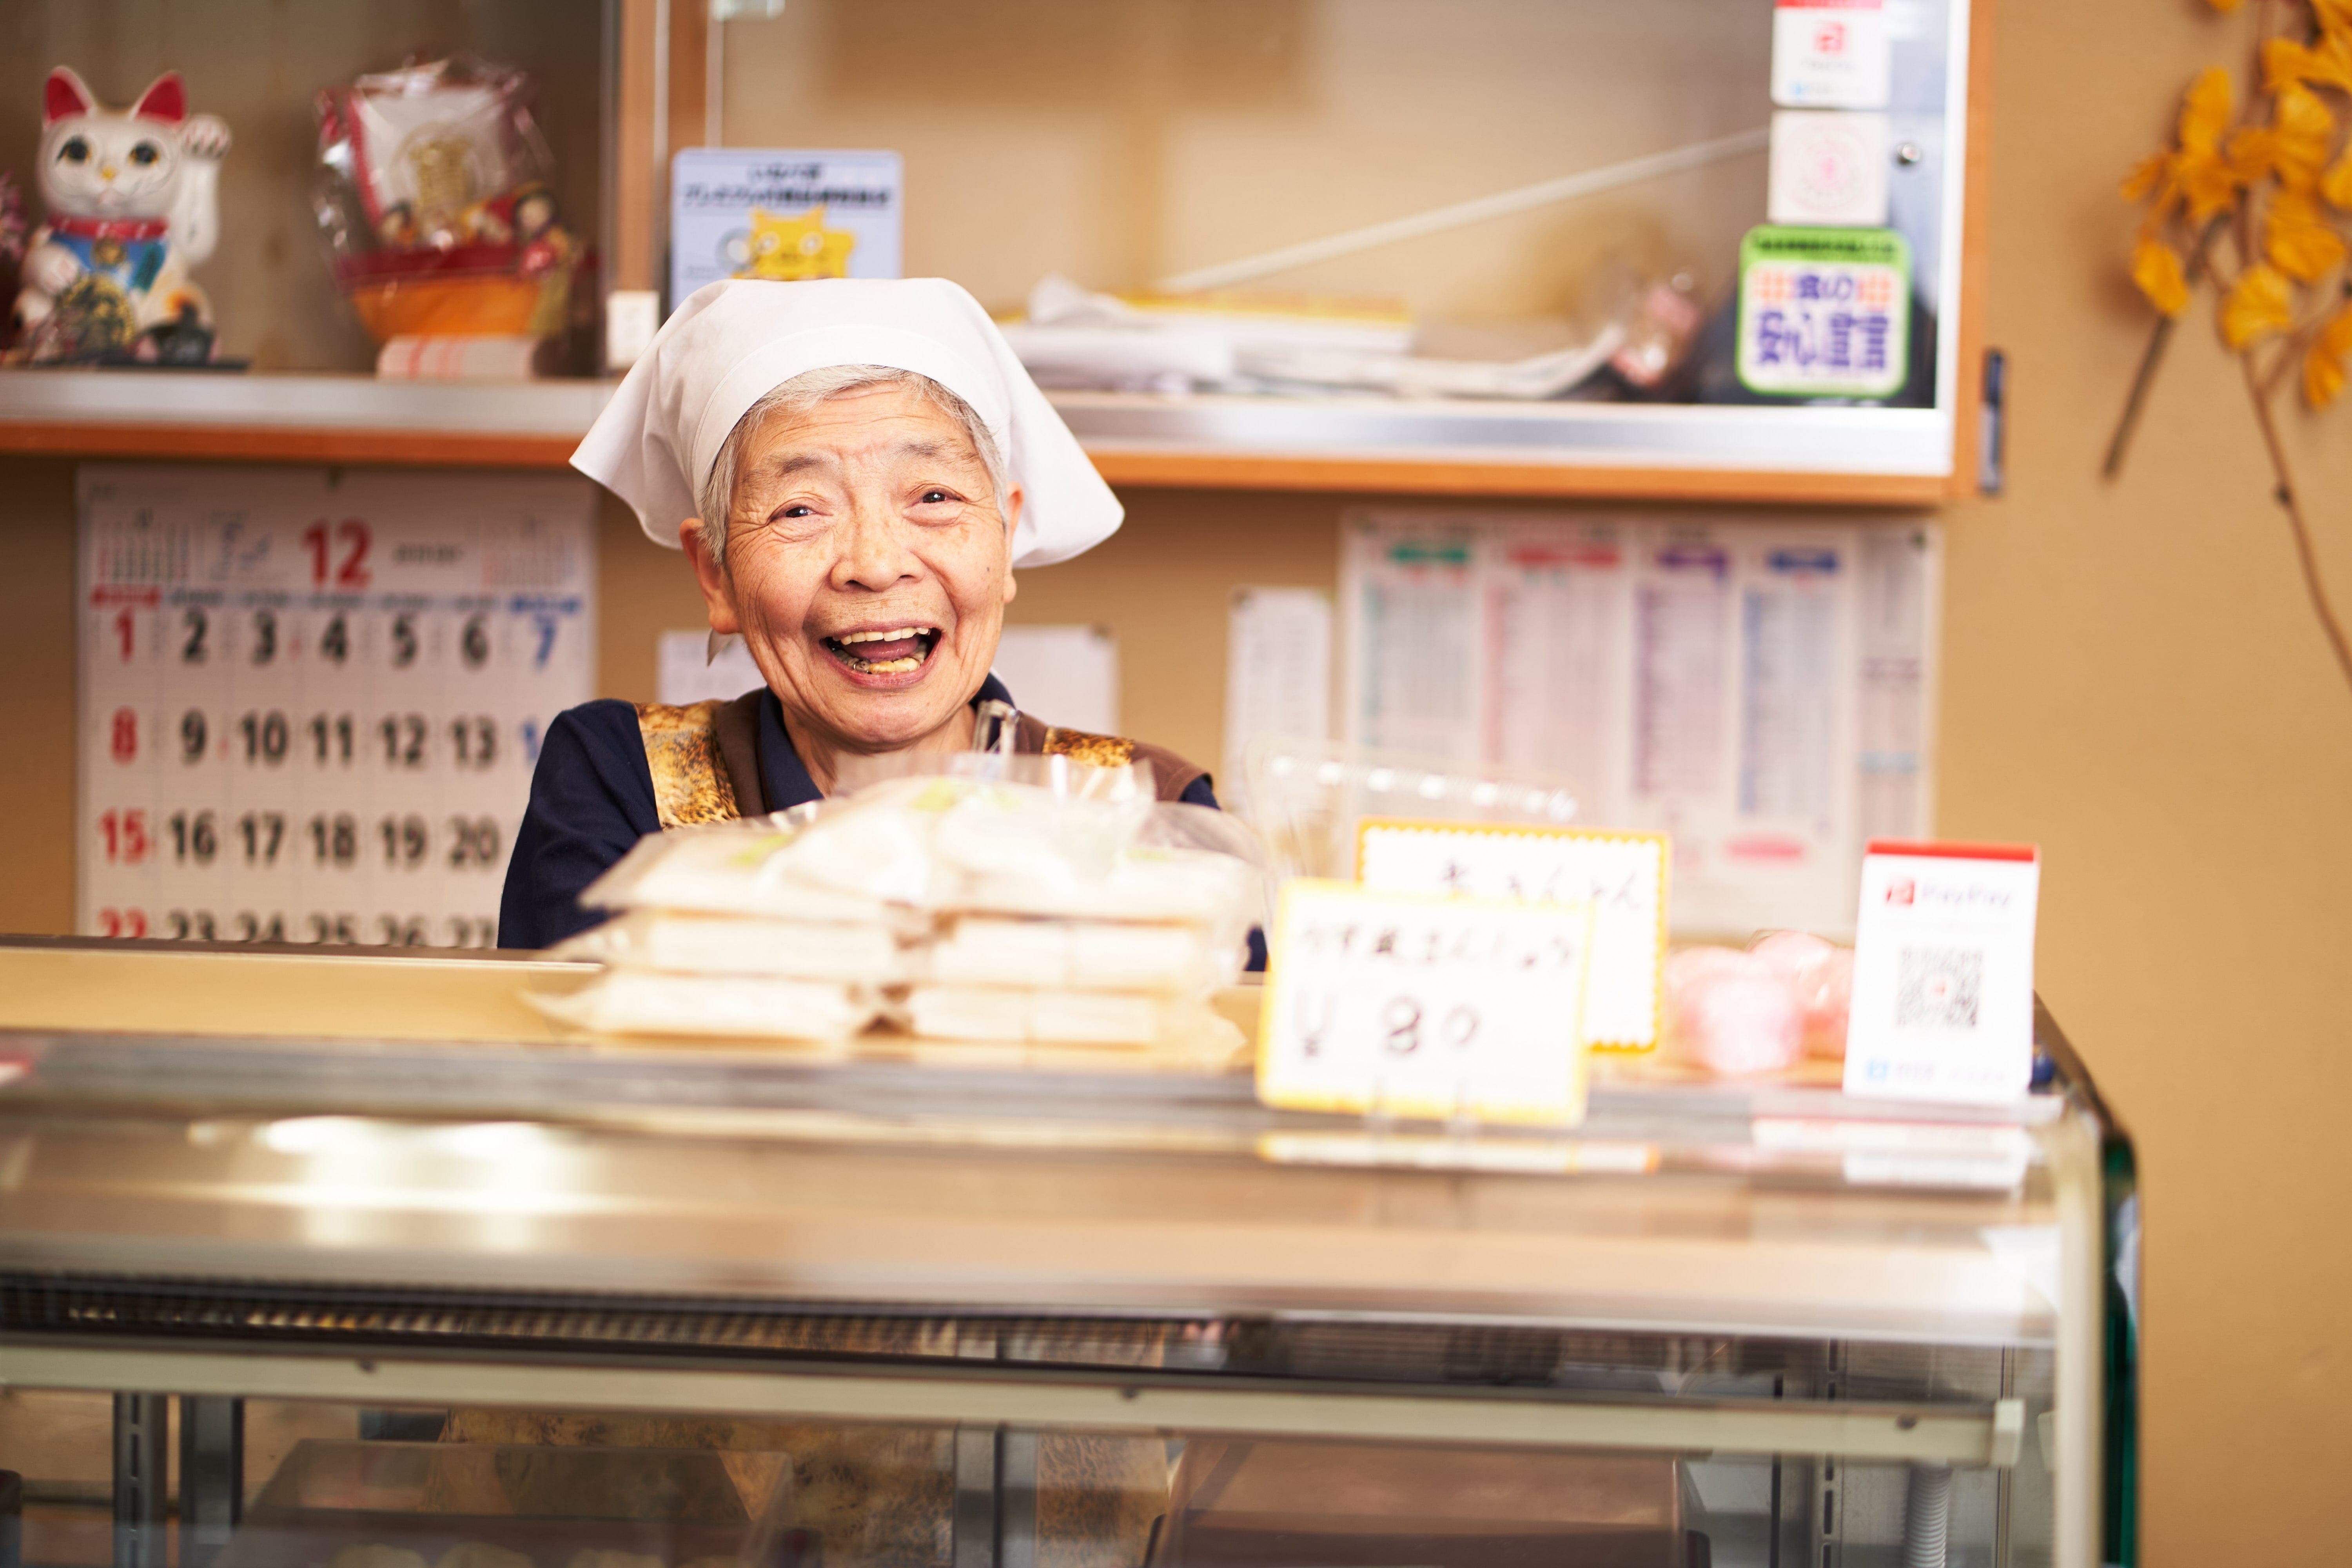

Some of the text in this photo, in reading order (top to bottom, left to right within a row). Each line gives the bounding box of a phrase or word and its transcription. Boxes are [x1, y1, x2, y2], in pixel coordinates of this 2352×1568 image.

[302, 517, 373, 588] 12
[114, 606, 559, 671] 1 2 3 4 5 6 7
[112, 709, 540, 768] 8 9 10 11 12 13 1
[99, 808, 500, 868] 15 16 17 18 19 20
